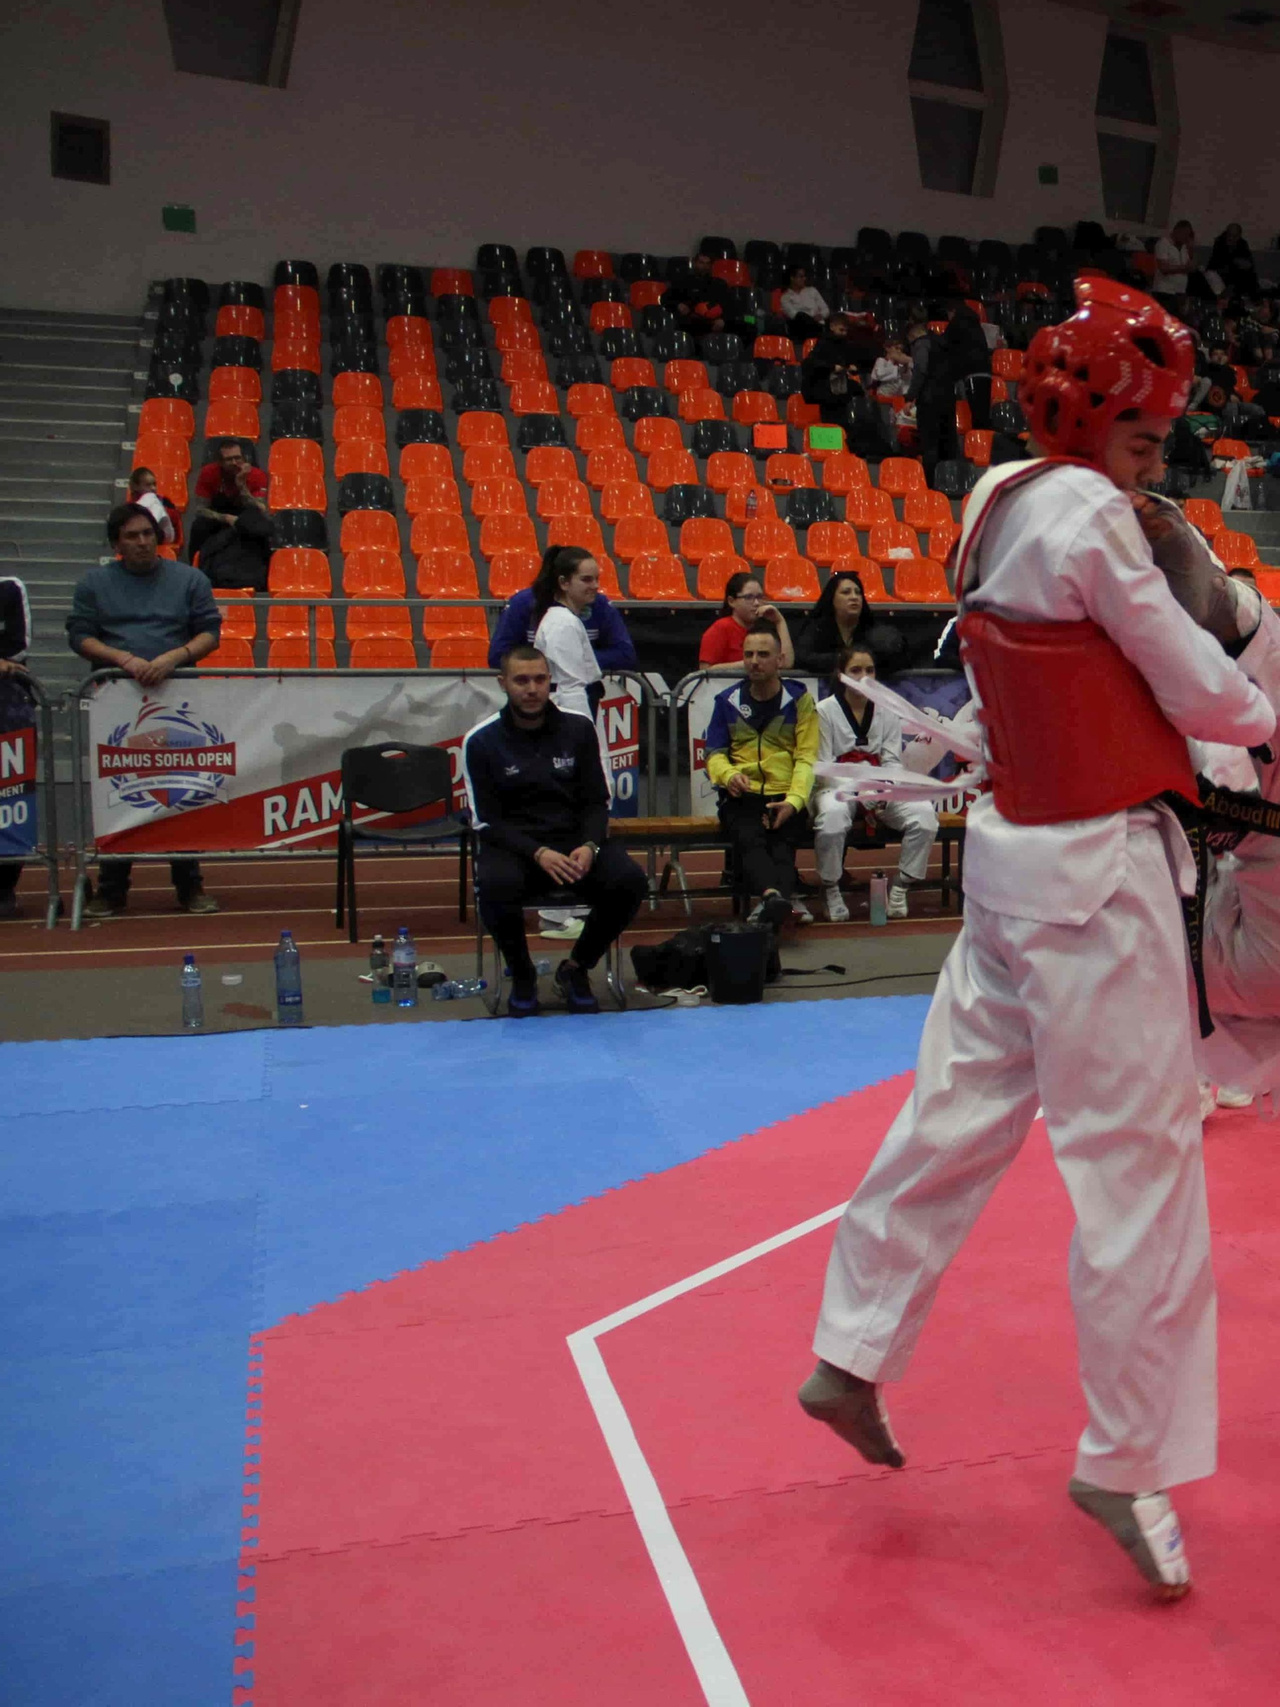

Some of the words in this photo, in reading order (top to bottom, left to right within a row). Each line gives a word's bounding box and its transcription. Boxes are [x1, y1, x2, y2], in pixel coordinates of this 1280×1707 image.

[101, 753, 151, 768] RAMUS
[154, 753, 194, 767] SOFIA
[197, 752, 233, 767] OPEN
[263, 780, 369, 837] RAM
